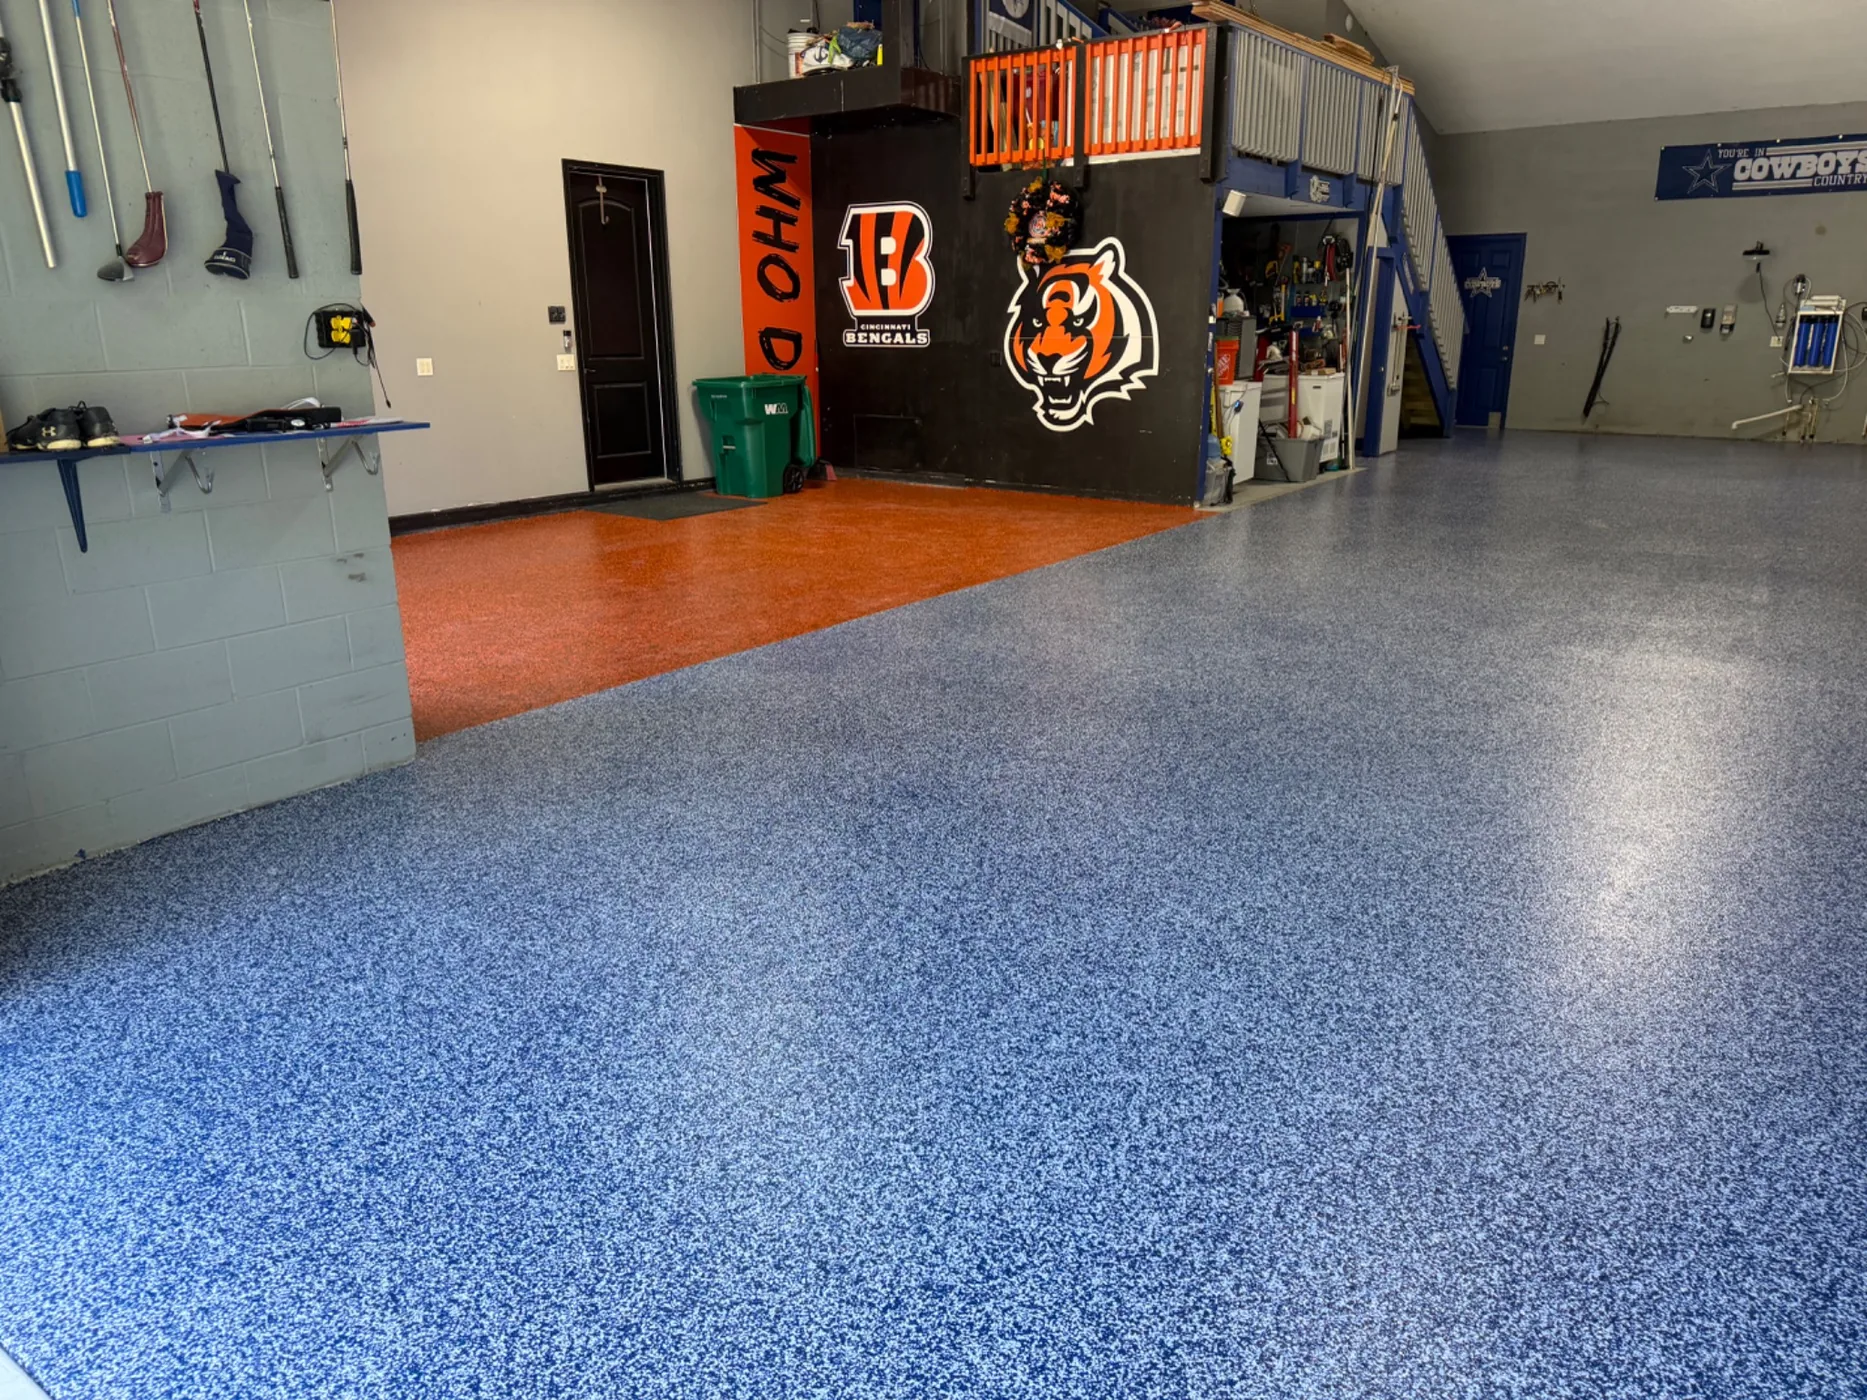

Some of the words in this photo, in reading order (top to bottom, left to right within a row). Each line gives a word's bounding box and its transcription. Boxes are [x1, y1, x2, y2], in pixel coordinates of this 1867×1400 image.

[1718, 148, 1749, 159] YOU'RE
[1755, 147, 1766, 157] IN
[1733, 150, 1867, 181] COWBOYS
[1814, 173, 1867, 187] COUNTRY
[751, 147, 802, 304] WHO
[860, 323, 911, 331] CINCINNATI
[846, 332, 928, 344] BENGALS
[764, 403, 788, 415] WM
